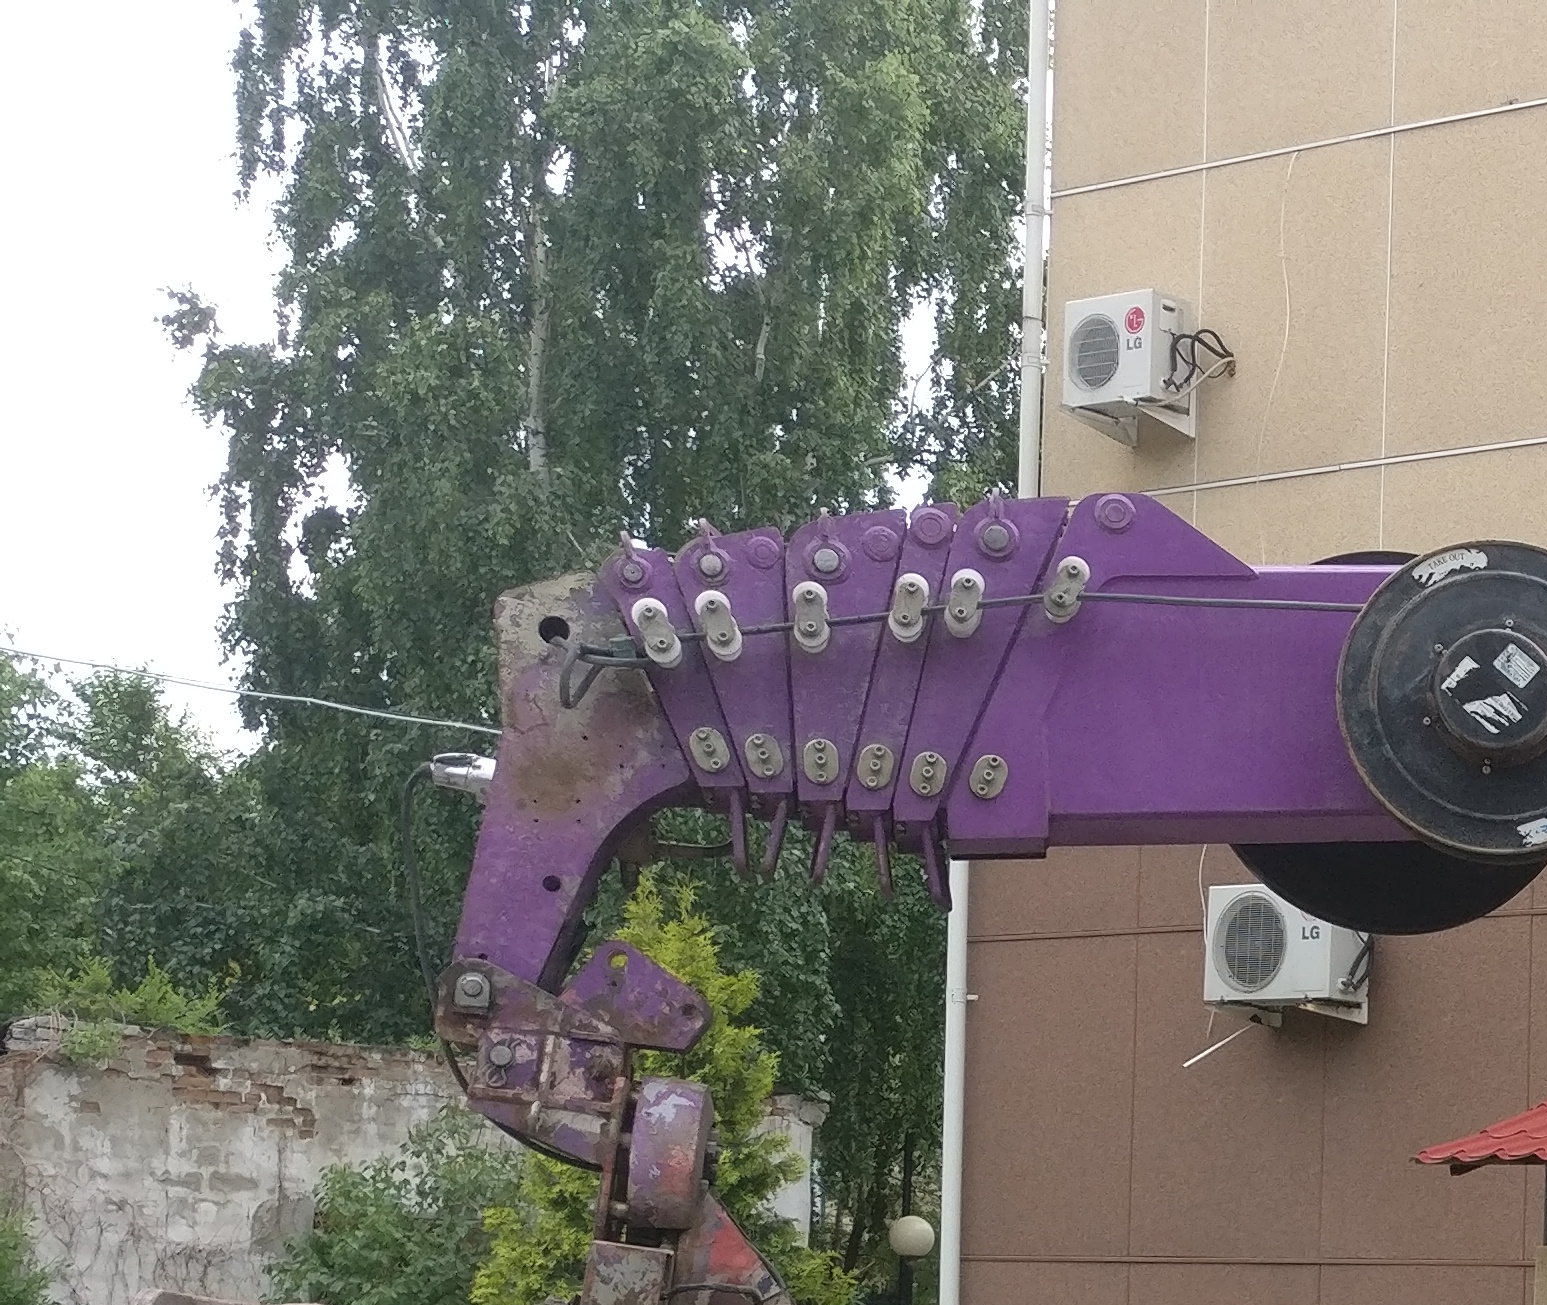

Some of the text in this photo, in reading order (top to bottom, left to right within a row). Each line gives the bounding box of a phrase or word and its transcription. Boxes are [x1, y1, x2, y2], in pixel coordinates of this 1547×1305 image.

[1126, 337, 1142, 351] LG
[1427, 556, 1448, 570] TAKE
[1448, 552, 1465, 562] OUT
[1301, 925, 1321, 940] LG
